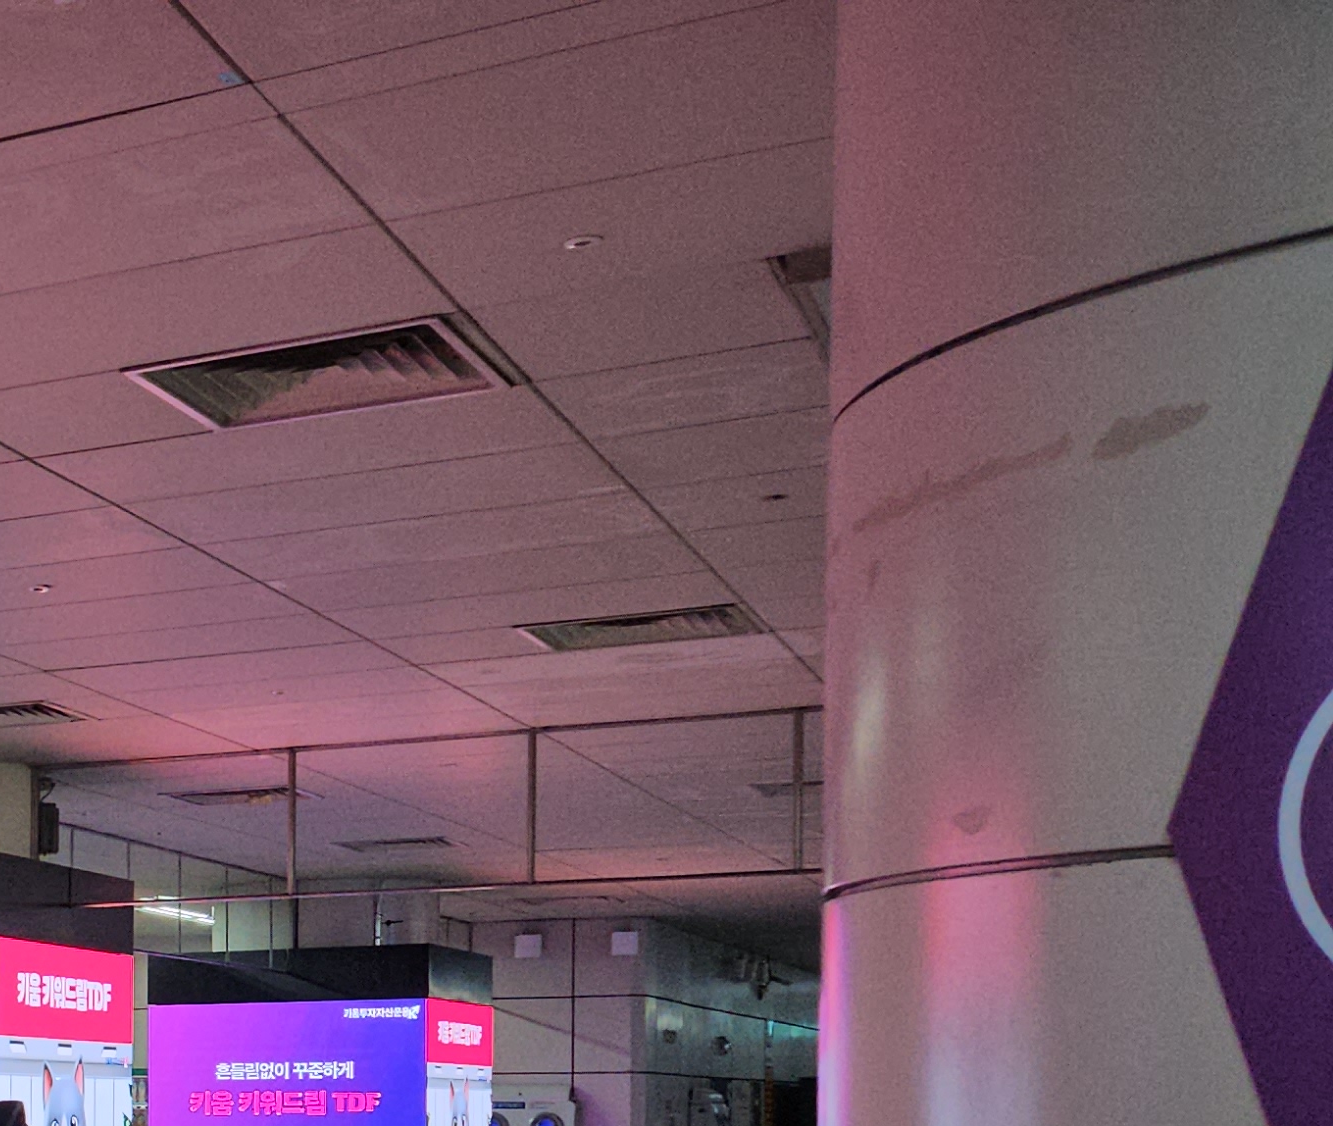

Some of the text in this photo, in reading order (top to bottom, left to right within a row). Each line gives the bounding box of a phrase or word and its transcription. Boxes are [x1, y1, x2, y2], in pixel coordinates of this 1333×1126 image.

[17, 972, 112, 1012] 키움 키워드림TDF
[215, 1060, 355, 1080] 흔들림없이 꾸준하게
[189, 1089, 382, 1116] 키움 키워드림 TDF
